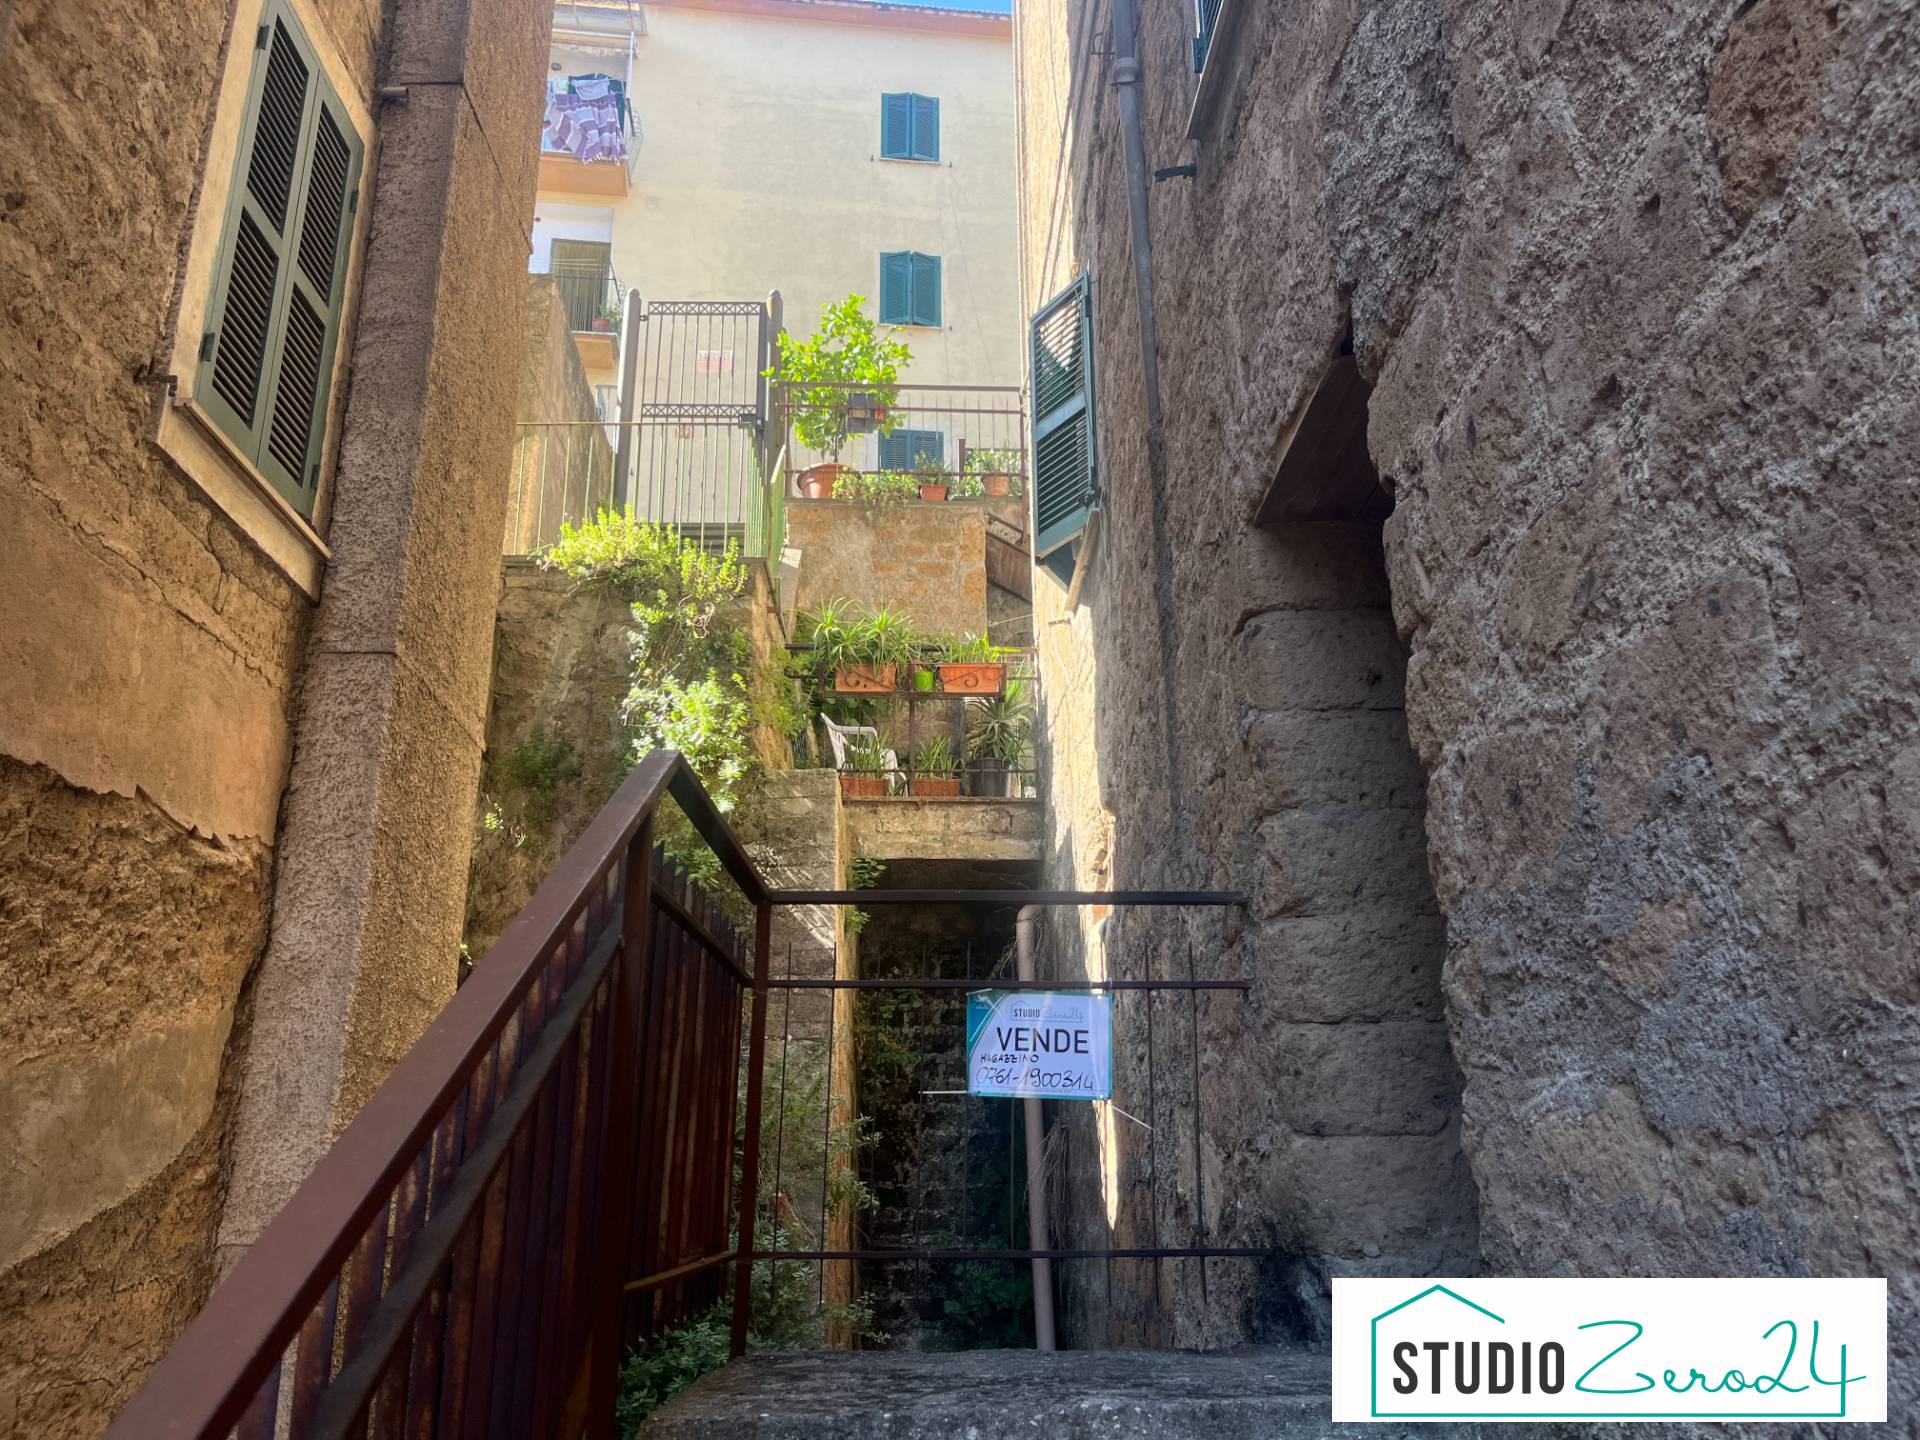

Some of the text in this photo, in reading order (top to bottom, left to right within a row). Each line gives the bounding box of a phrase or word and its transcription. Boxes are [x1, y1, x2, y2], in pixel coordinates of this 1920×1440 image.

[1013, 1008, 1041, 1018] STUDIO
[996, 1027, 1090, 1054] VENDE
[976, 1067, 1094, 1091] 0761-1900314
